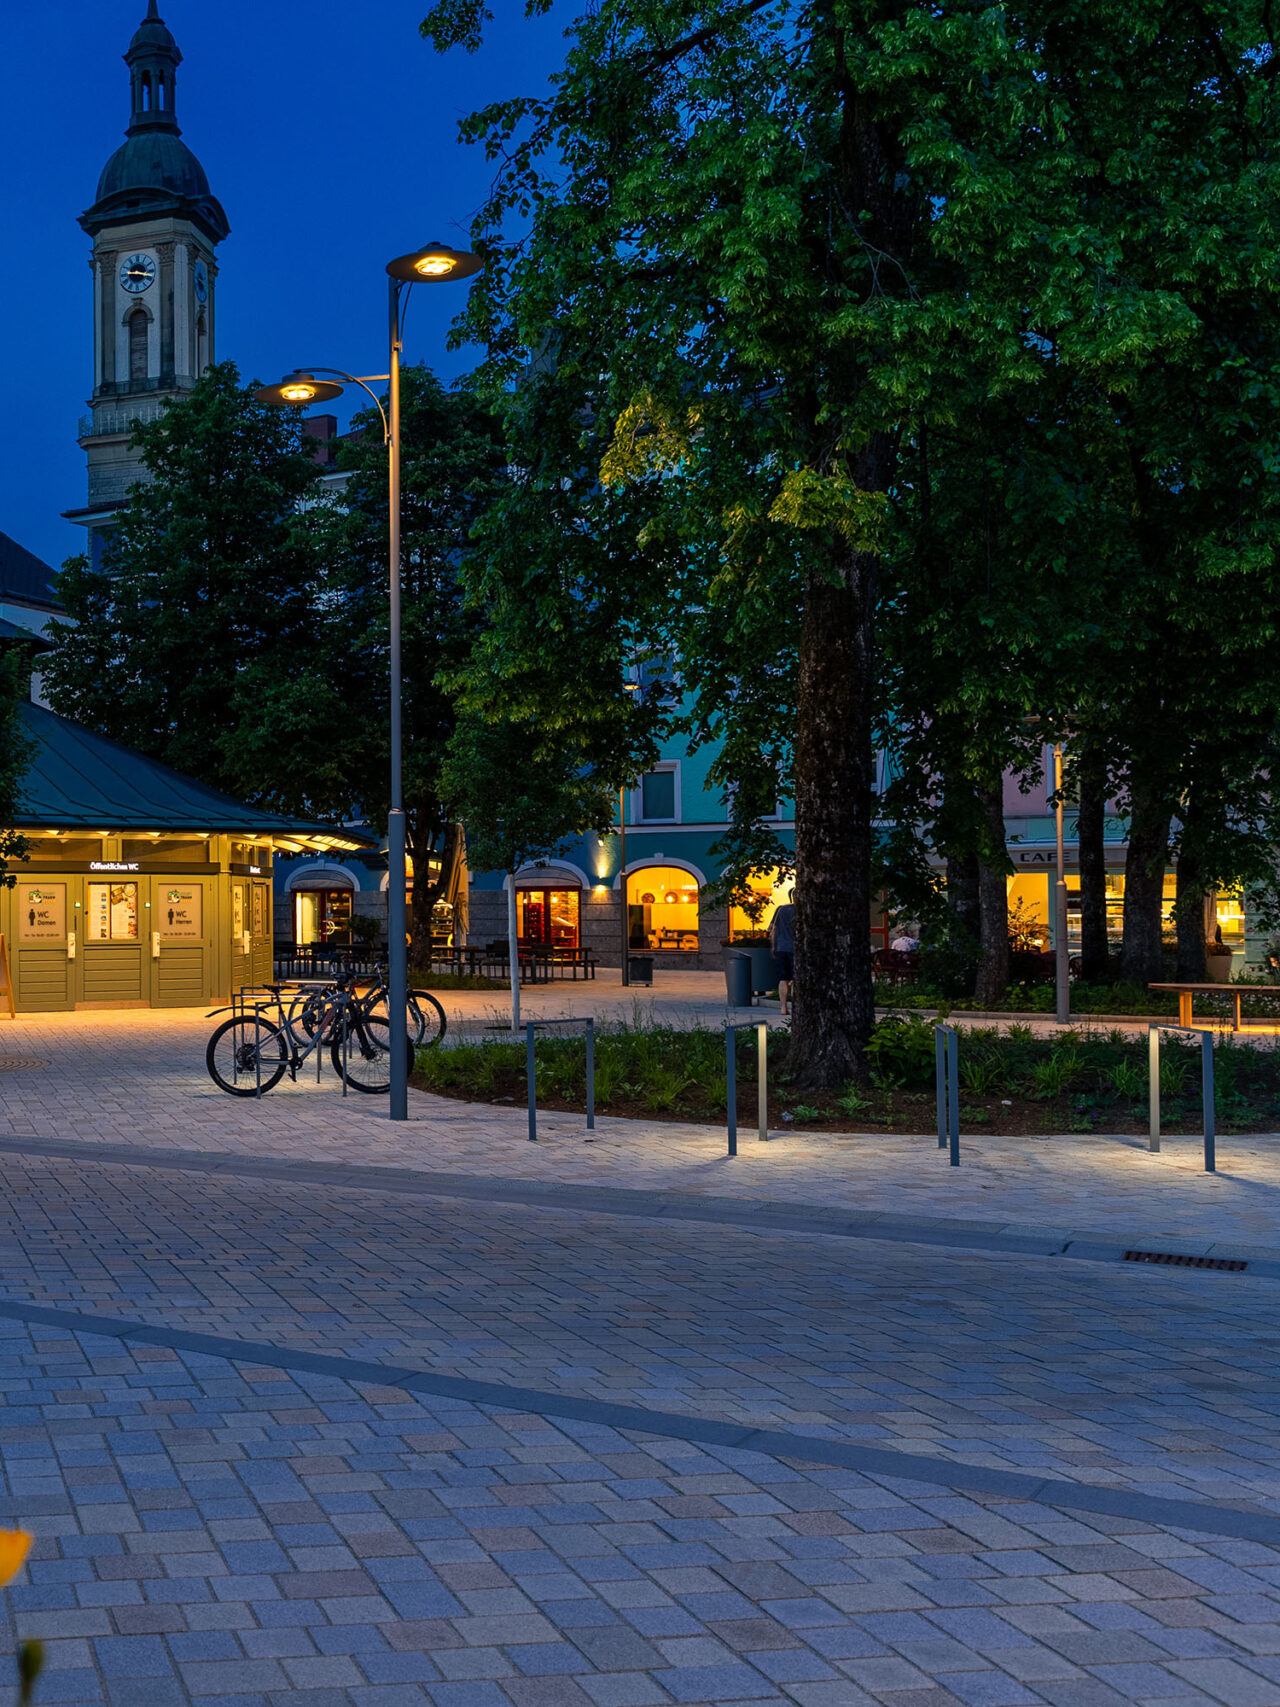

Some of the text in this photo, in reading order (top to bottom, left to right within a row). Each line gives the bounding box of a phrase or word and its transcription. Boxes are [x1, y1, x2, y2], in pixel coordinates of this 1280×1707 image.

[127, 862, 139, 871] WC
[37, 910, 49, 918] WC
[175, 910, 187, 918] WC
